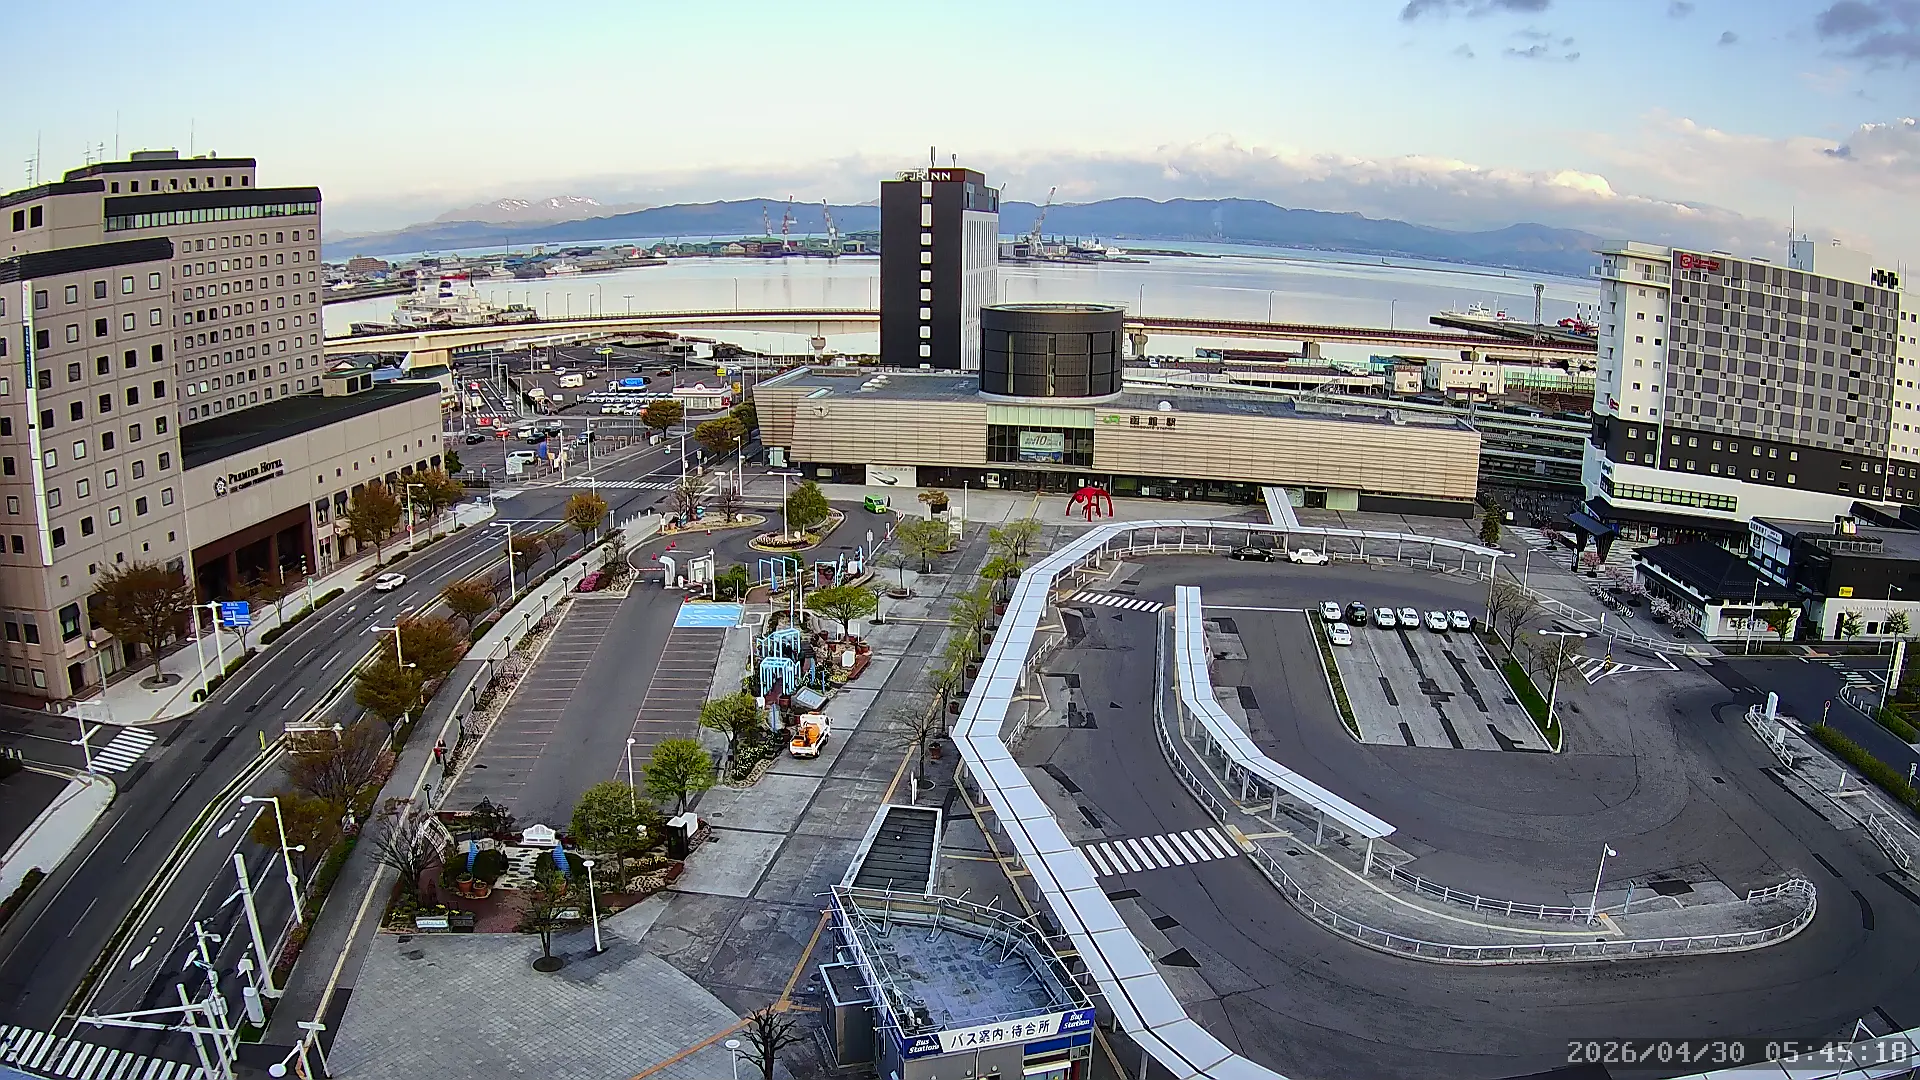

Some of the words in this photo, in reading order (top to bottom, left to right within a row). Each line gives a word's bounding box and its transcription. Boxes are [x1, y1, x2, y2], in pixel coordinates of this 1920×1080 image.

[926, 171, 951, 181] INN
[1070, 1012, 1083, 1022] Bus
[1063, 1019, 1090, 1029] Station
[915, 1038, 930, 1047] Bus
[908, 1044, 940, 1054] Station
